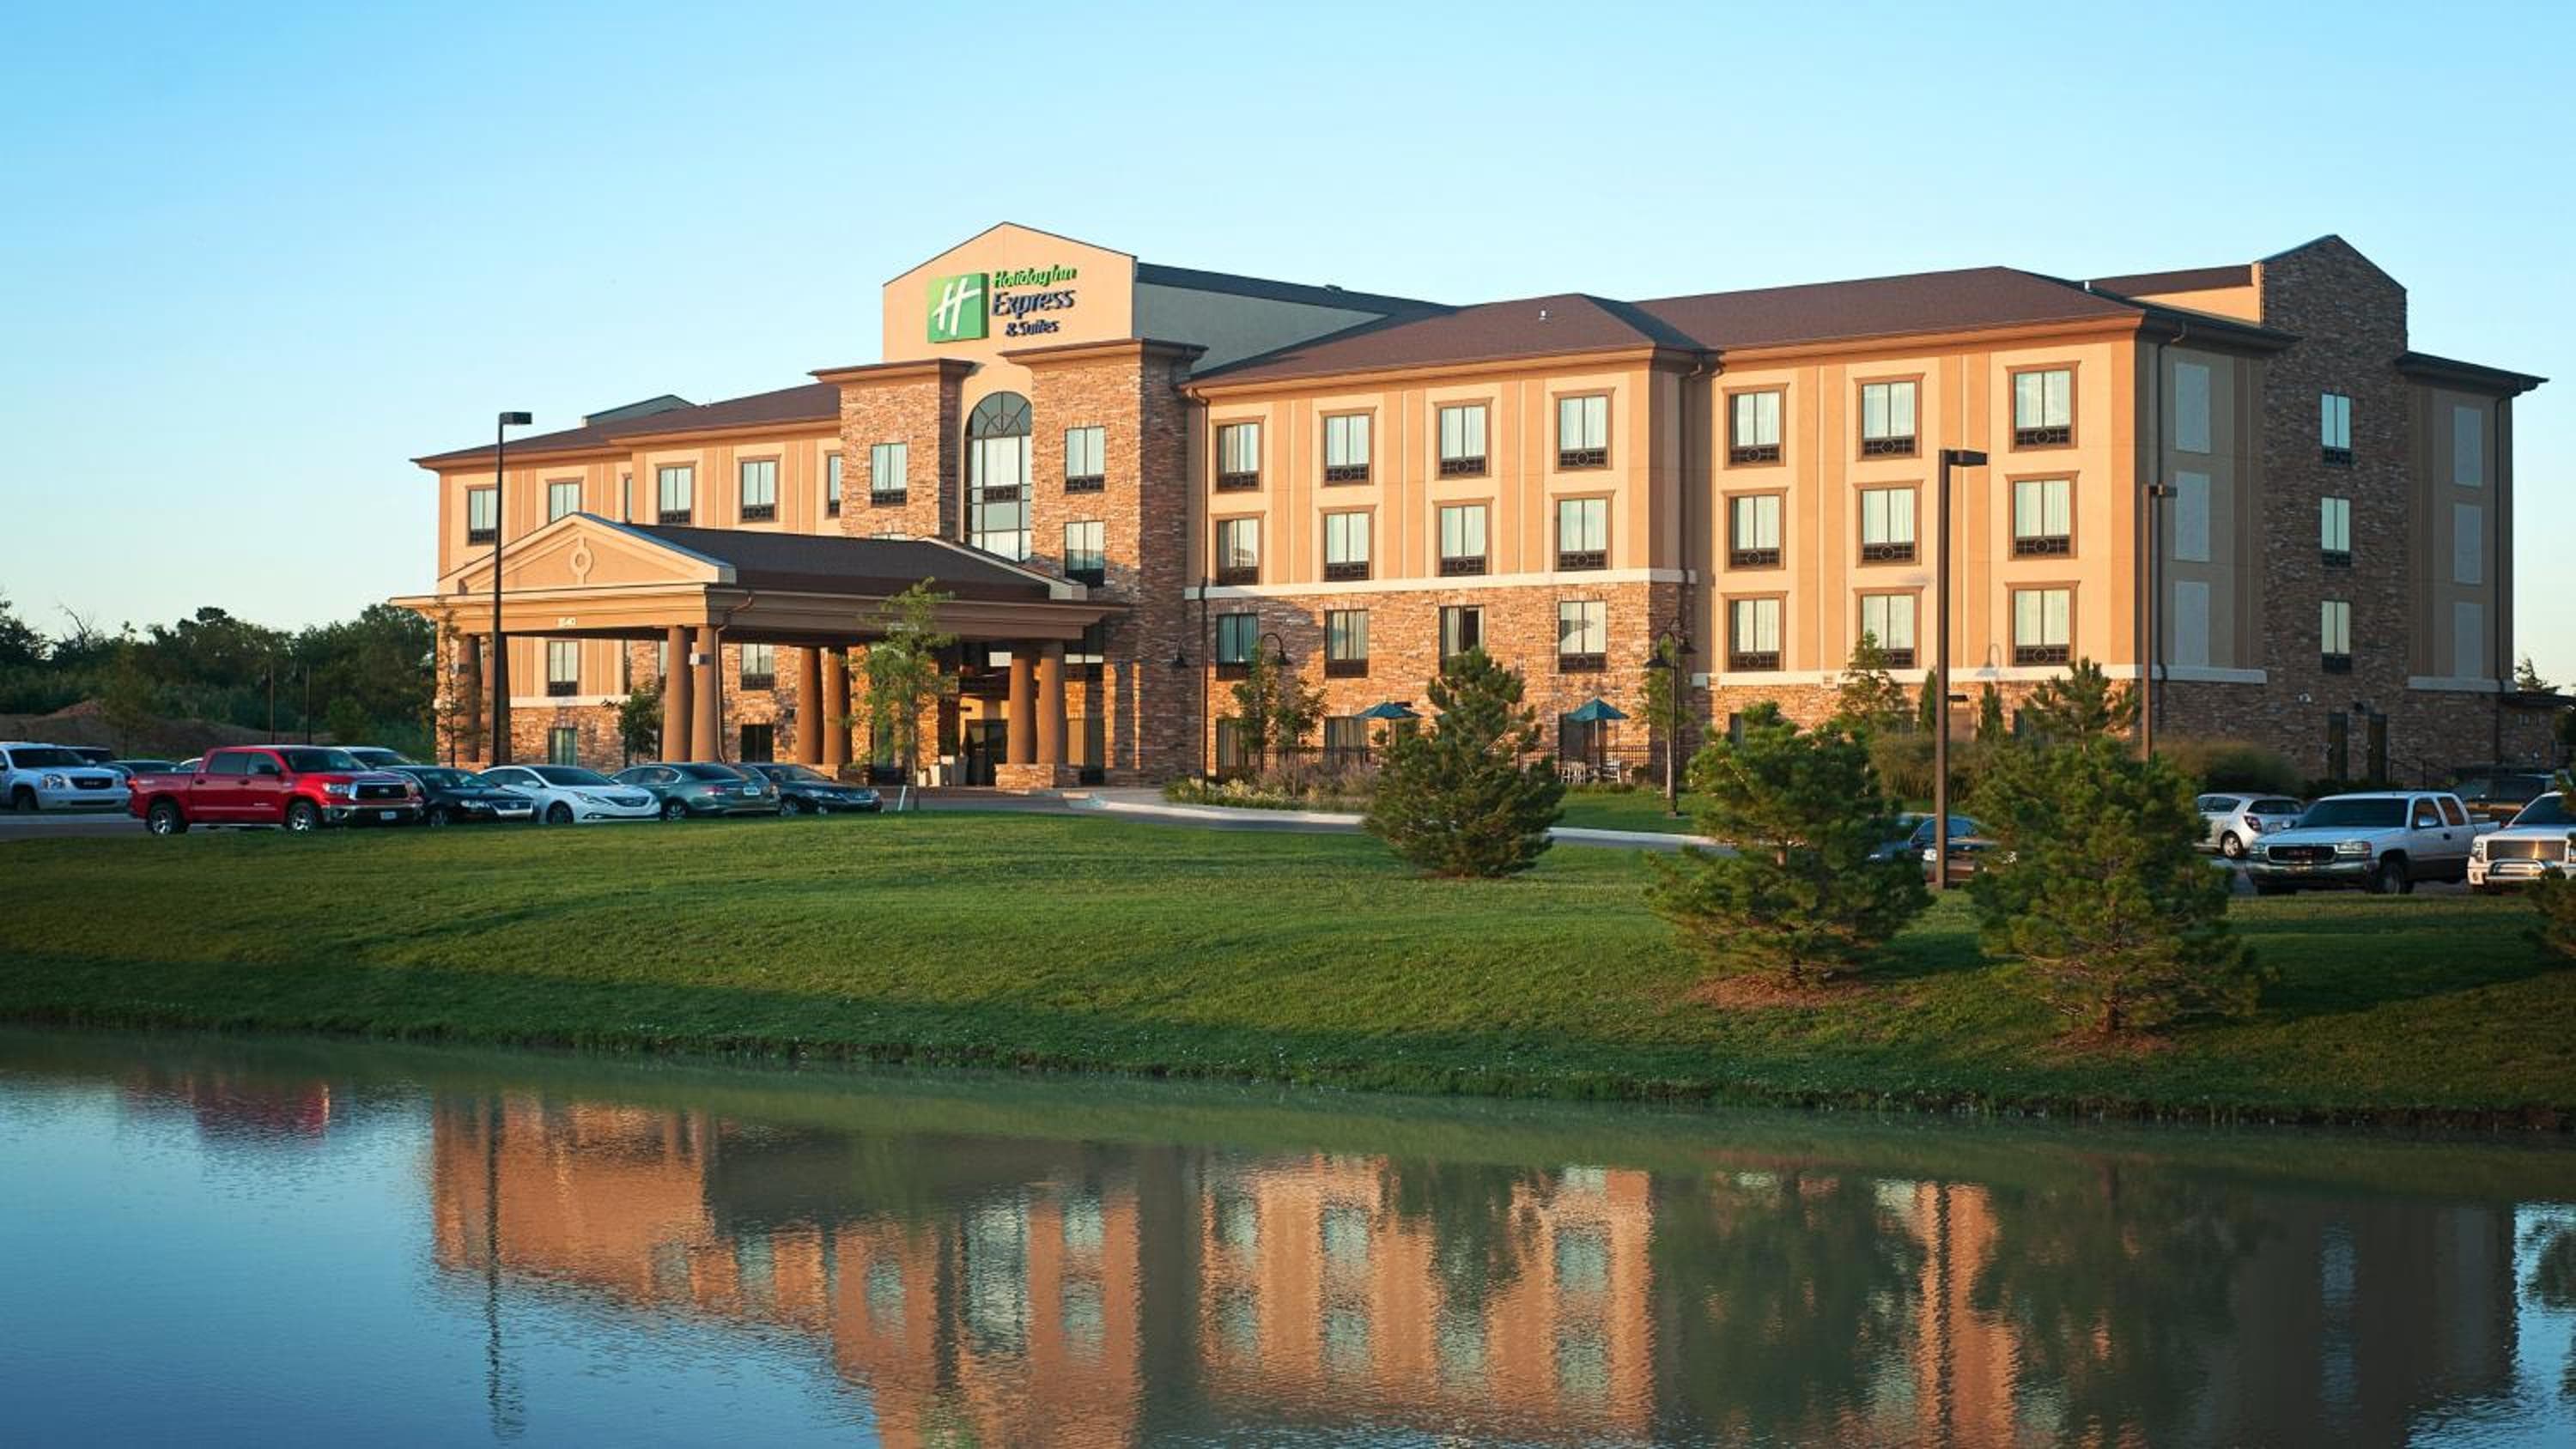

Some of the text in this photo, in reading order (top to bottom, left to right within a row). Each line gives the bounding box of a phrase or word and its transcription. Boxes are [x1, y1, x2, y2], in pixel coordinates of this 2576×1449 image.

[993, 264, 1077, 288] Holiday Inn
[932, 277, 981, 336] H
[992, 289, 1076, 319] Express
[1005, 319, 1060, 336] & Suites
